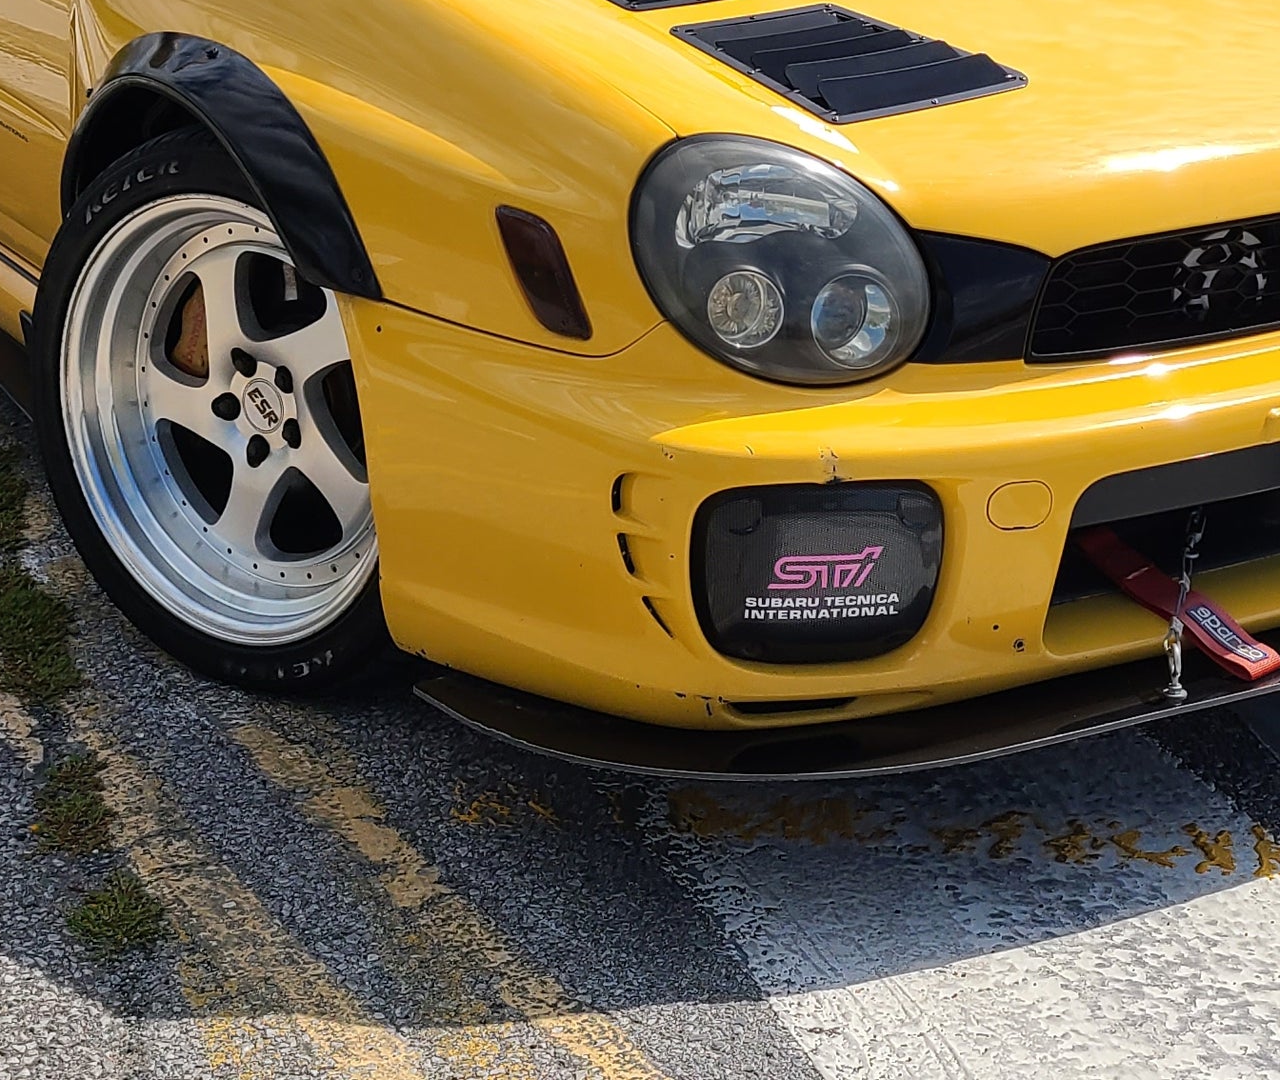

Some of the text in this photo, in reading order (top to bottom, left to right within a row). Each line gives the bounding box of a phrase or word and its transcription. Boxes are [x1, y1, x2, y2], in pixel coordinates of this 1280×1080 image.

[247, 386, 279, 427] ESR
[744, 593, 900, 608] SUBARU TECNICA
[744, 605, 899, 620] INTERNATIONAL
[1195, 606, 1265, 659] sparco
